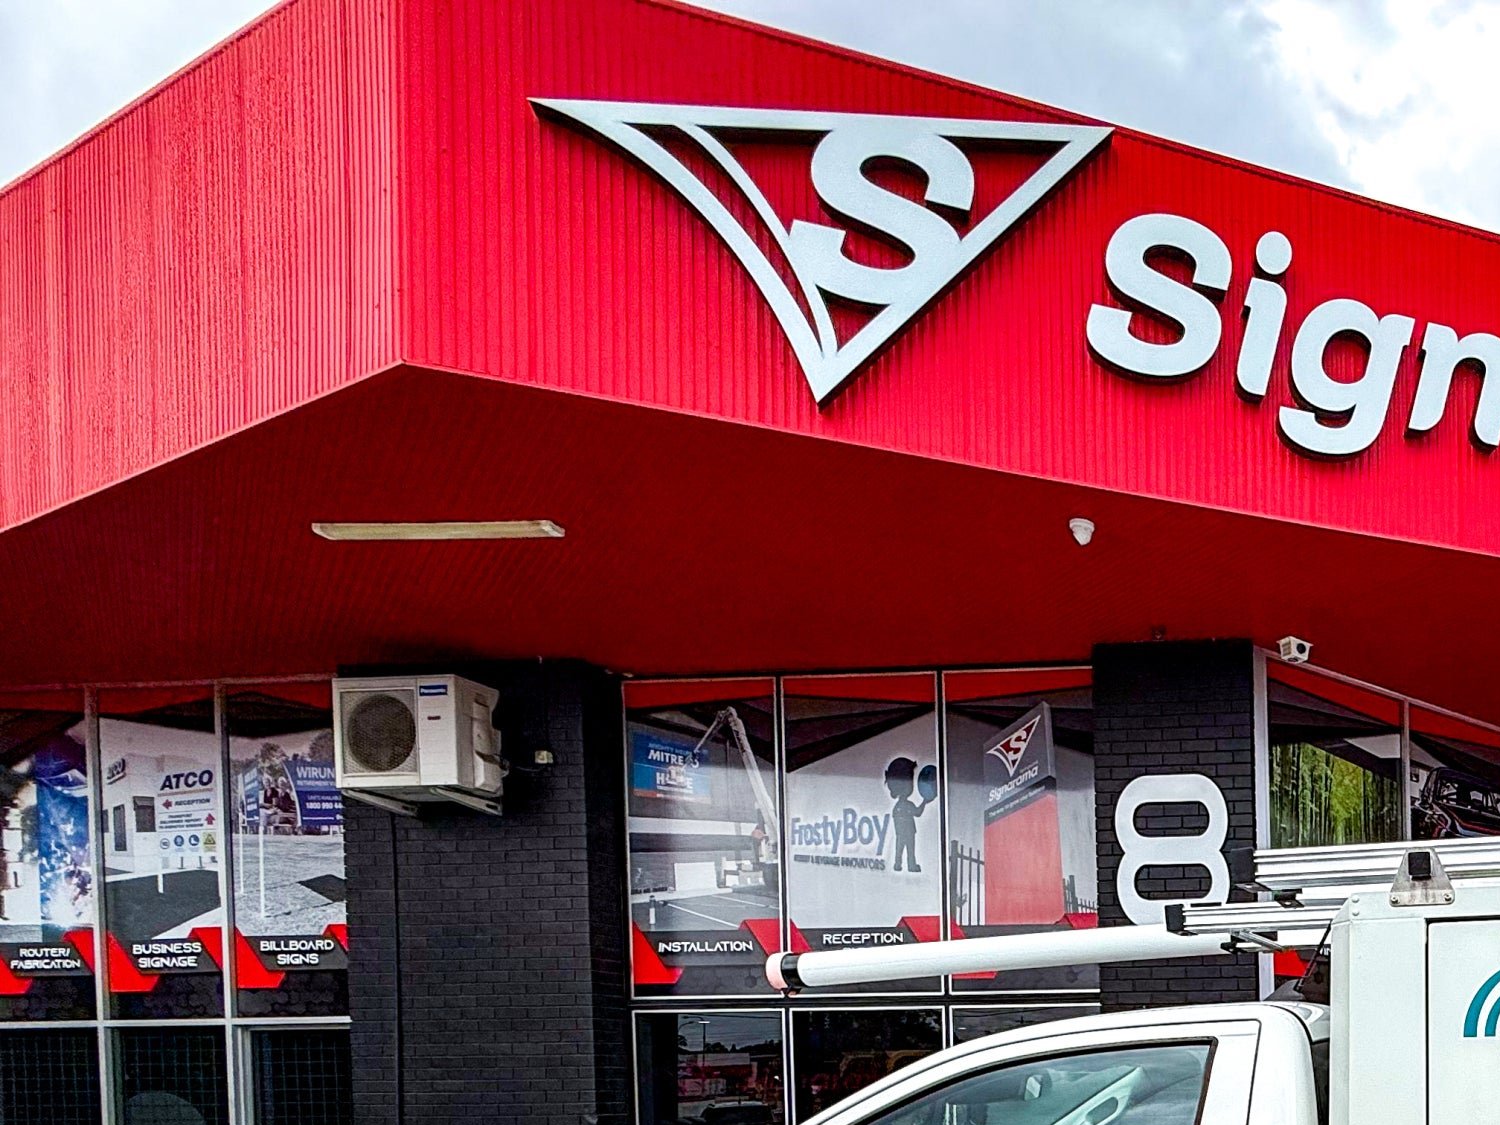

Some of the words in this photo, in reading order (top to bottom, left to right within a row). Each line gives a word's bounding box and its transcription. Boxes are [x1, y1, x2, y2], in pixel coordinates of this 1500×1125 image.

[648, 749, 684, 766] MITRE
[160, 769, 214, 791] ATCO
[656, 771, 693, 789] HE
[791, 807, 890, 856] FrostyBoy
[1114, 773, 1231, 926] 8
[822, 932, 904, 945] RECEPTION
[132, 942, 202, 955] BUSINESS
[259, 939, 335, 952] BILLBOARD
[658, 940, 754, 953] INSTALLATION
[19, 947, 71, 958] ROUTER/
[276, 953, 320, 965] SIGNS
[10, 958, 81, 970] FABRICATION
[138, 956, 198, 968] SIGNAGE
